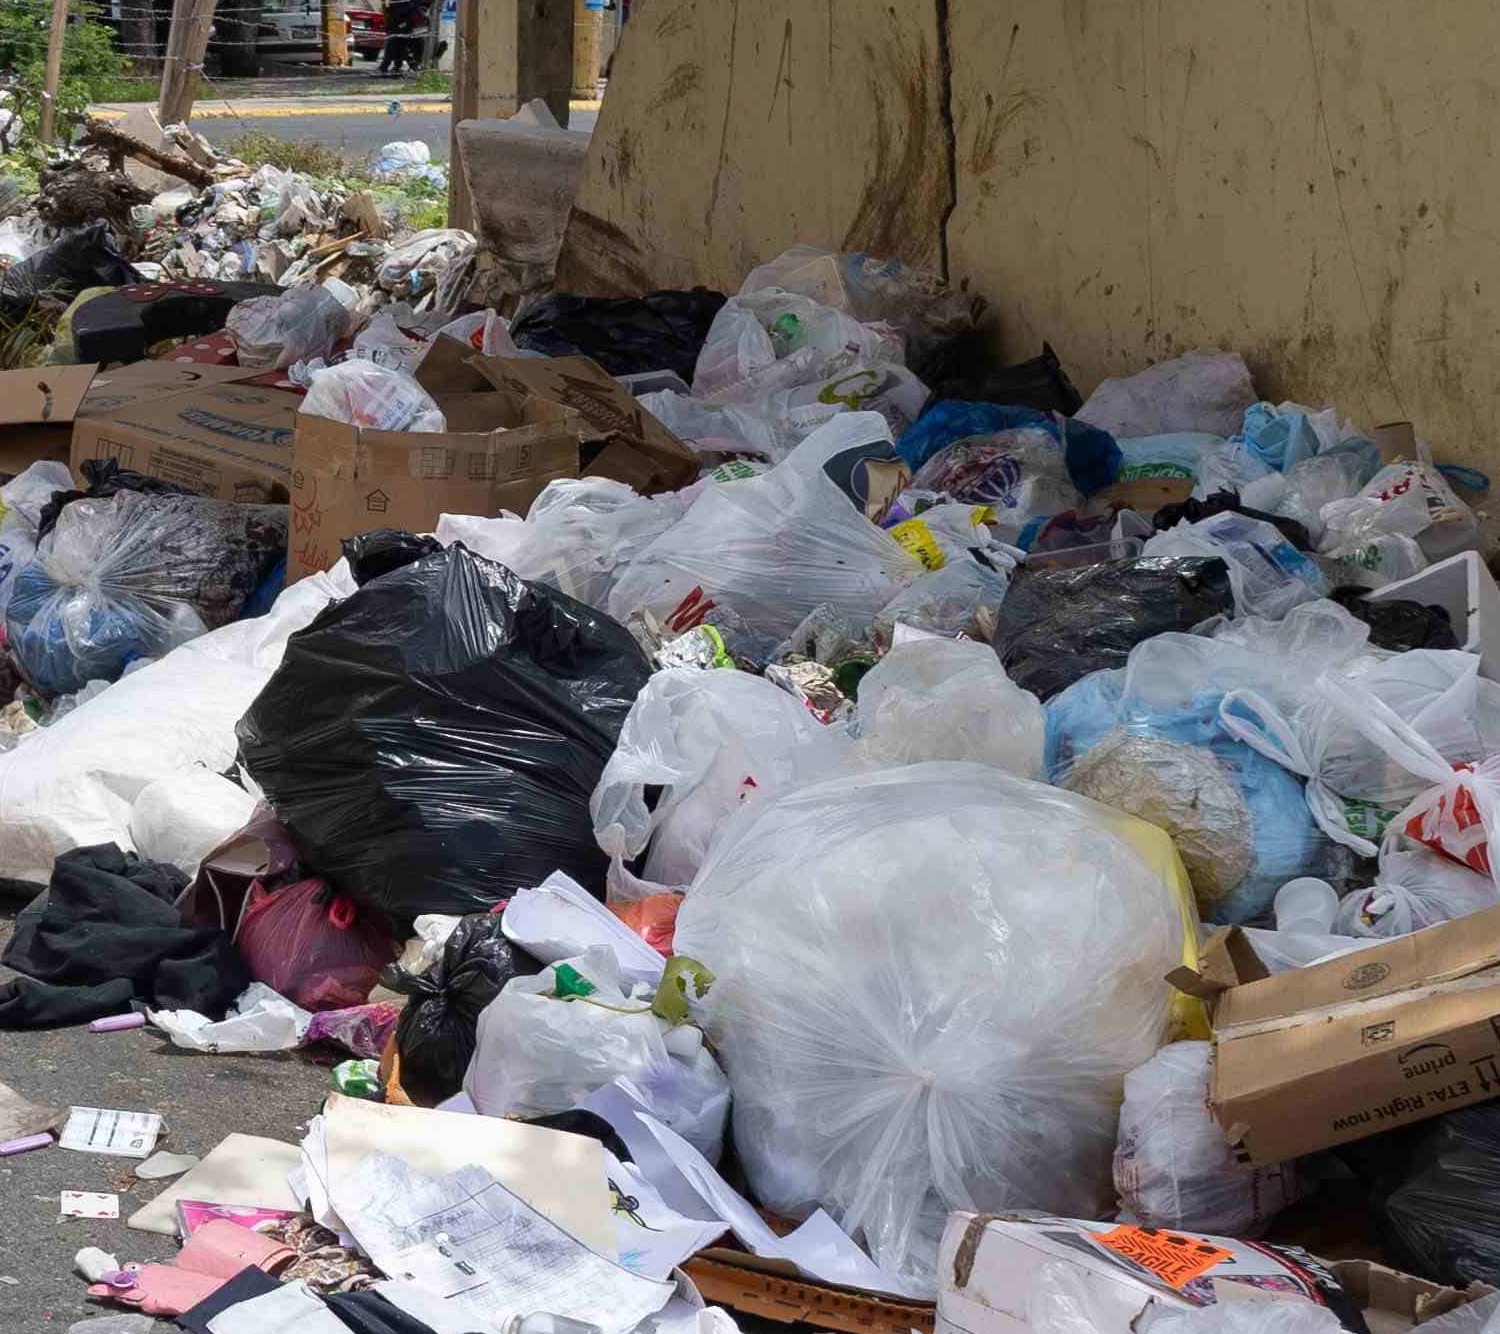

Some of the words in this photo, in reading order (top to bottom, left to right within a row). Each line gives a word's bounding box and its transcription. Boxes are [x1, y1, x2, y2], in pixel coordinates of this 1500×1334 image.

[1404, 1051, 1457, 1080] prime
[1427, 1080, 1471, 1103] ETA:
[1374, 1094, 1426, 1120] Right
[1333, 1113, 1372, 1132] now
